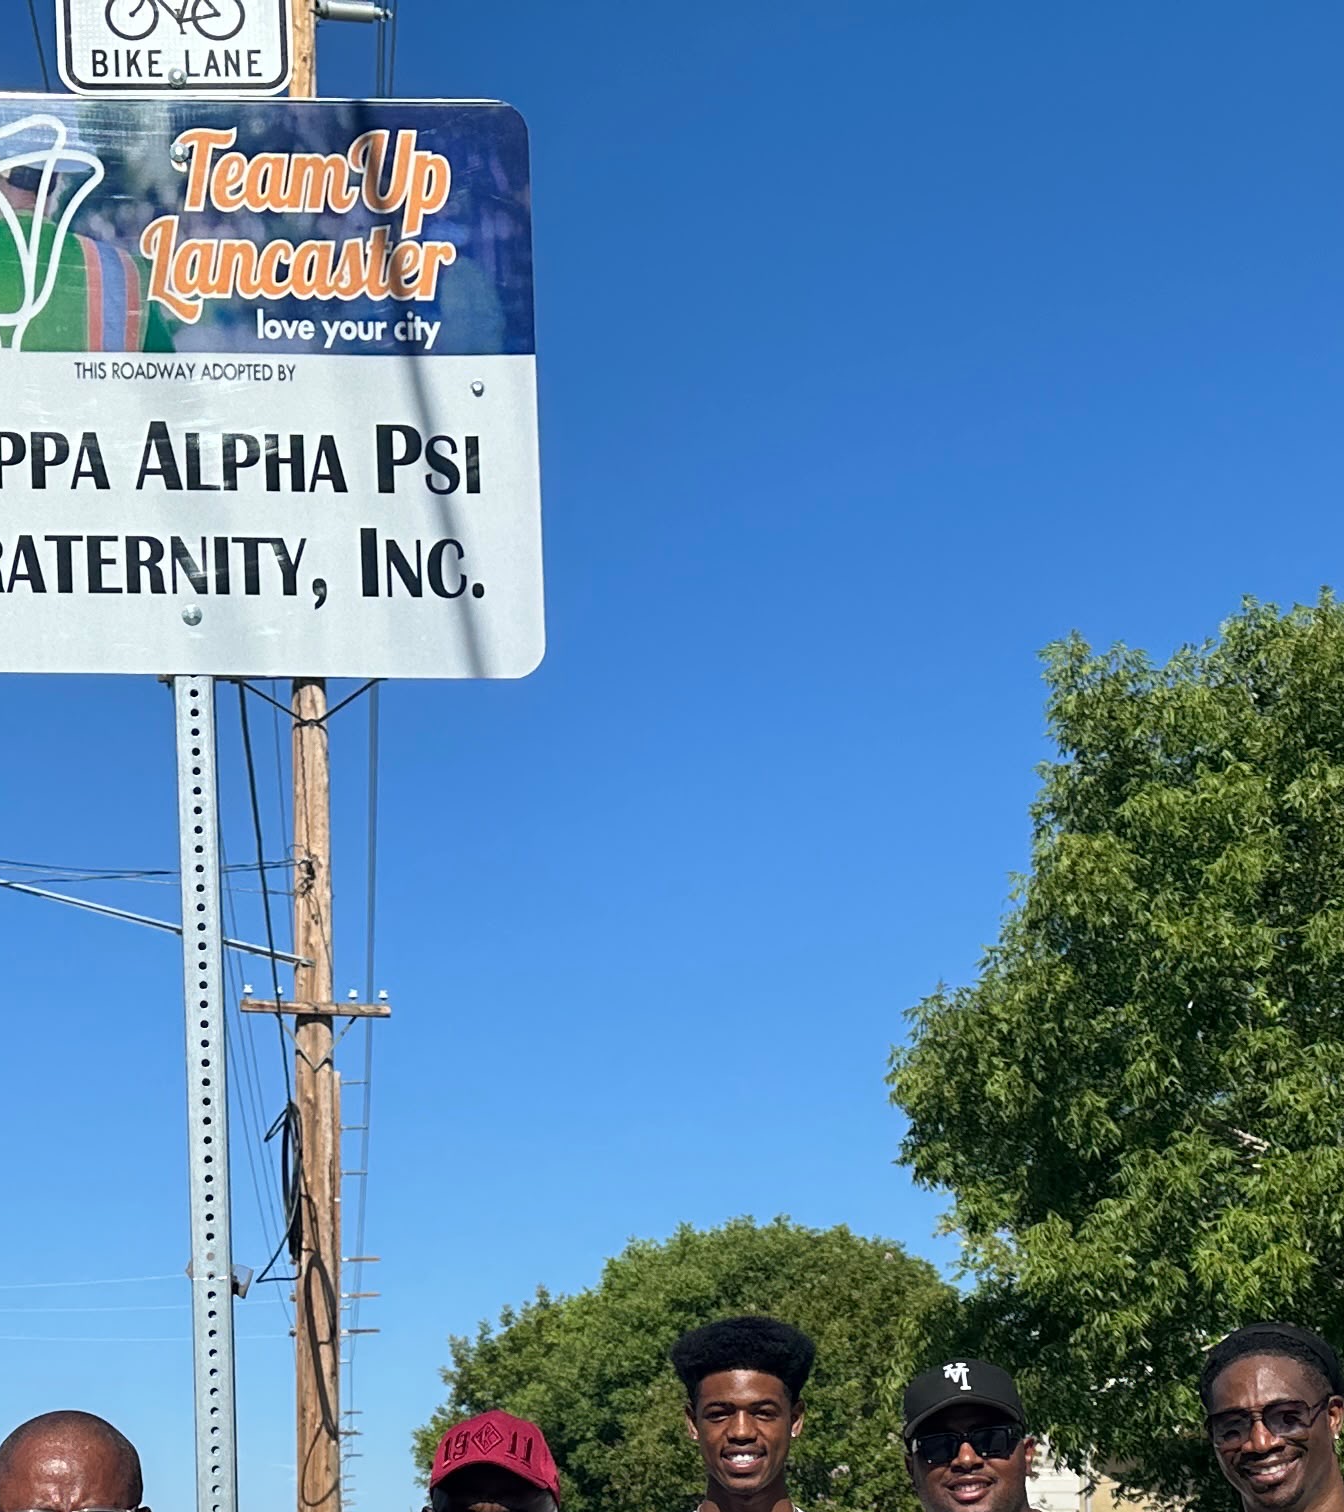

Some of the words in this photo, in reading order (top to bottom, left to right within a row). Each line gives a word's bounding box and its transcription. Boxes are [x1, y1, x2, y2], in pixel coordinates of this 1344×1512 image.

[91, 49, 159, 78] BIKE
[184, 49, 263, 78] LANE
[140, 216, 456, 324] Lancaster
[257, 309, 316, 340] love
[322, 318, 387, 349] your
[393, 315, 441, 349] city
[73, 361, 107, 380] THIS
[111, 361, 196, 381] ROADWAY
[201, 362, 274, 382] ADOPTED
[277, 363, 296, 382] BY
[135, 420, 349, 494] ALPHA
[375, 424, 482, 496] PSI
